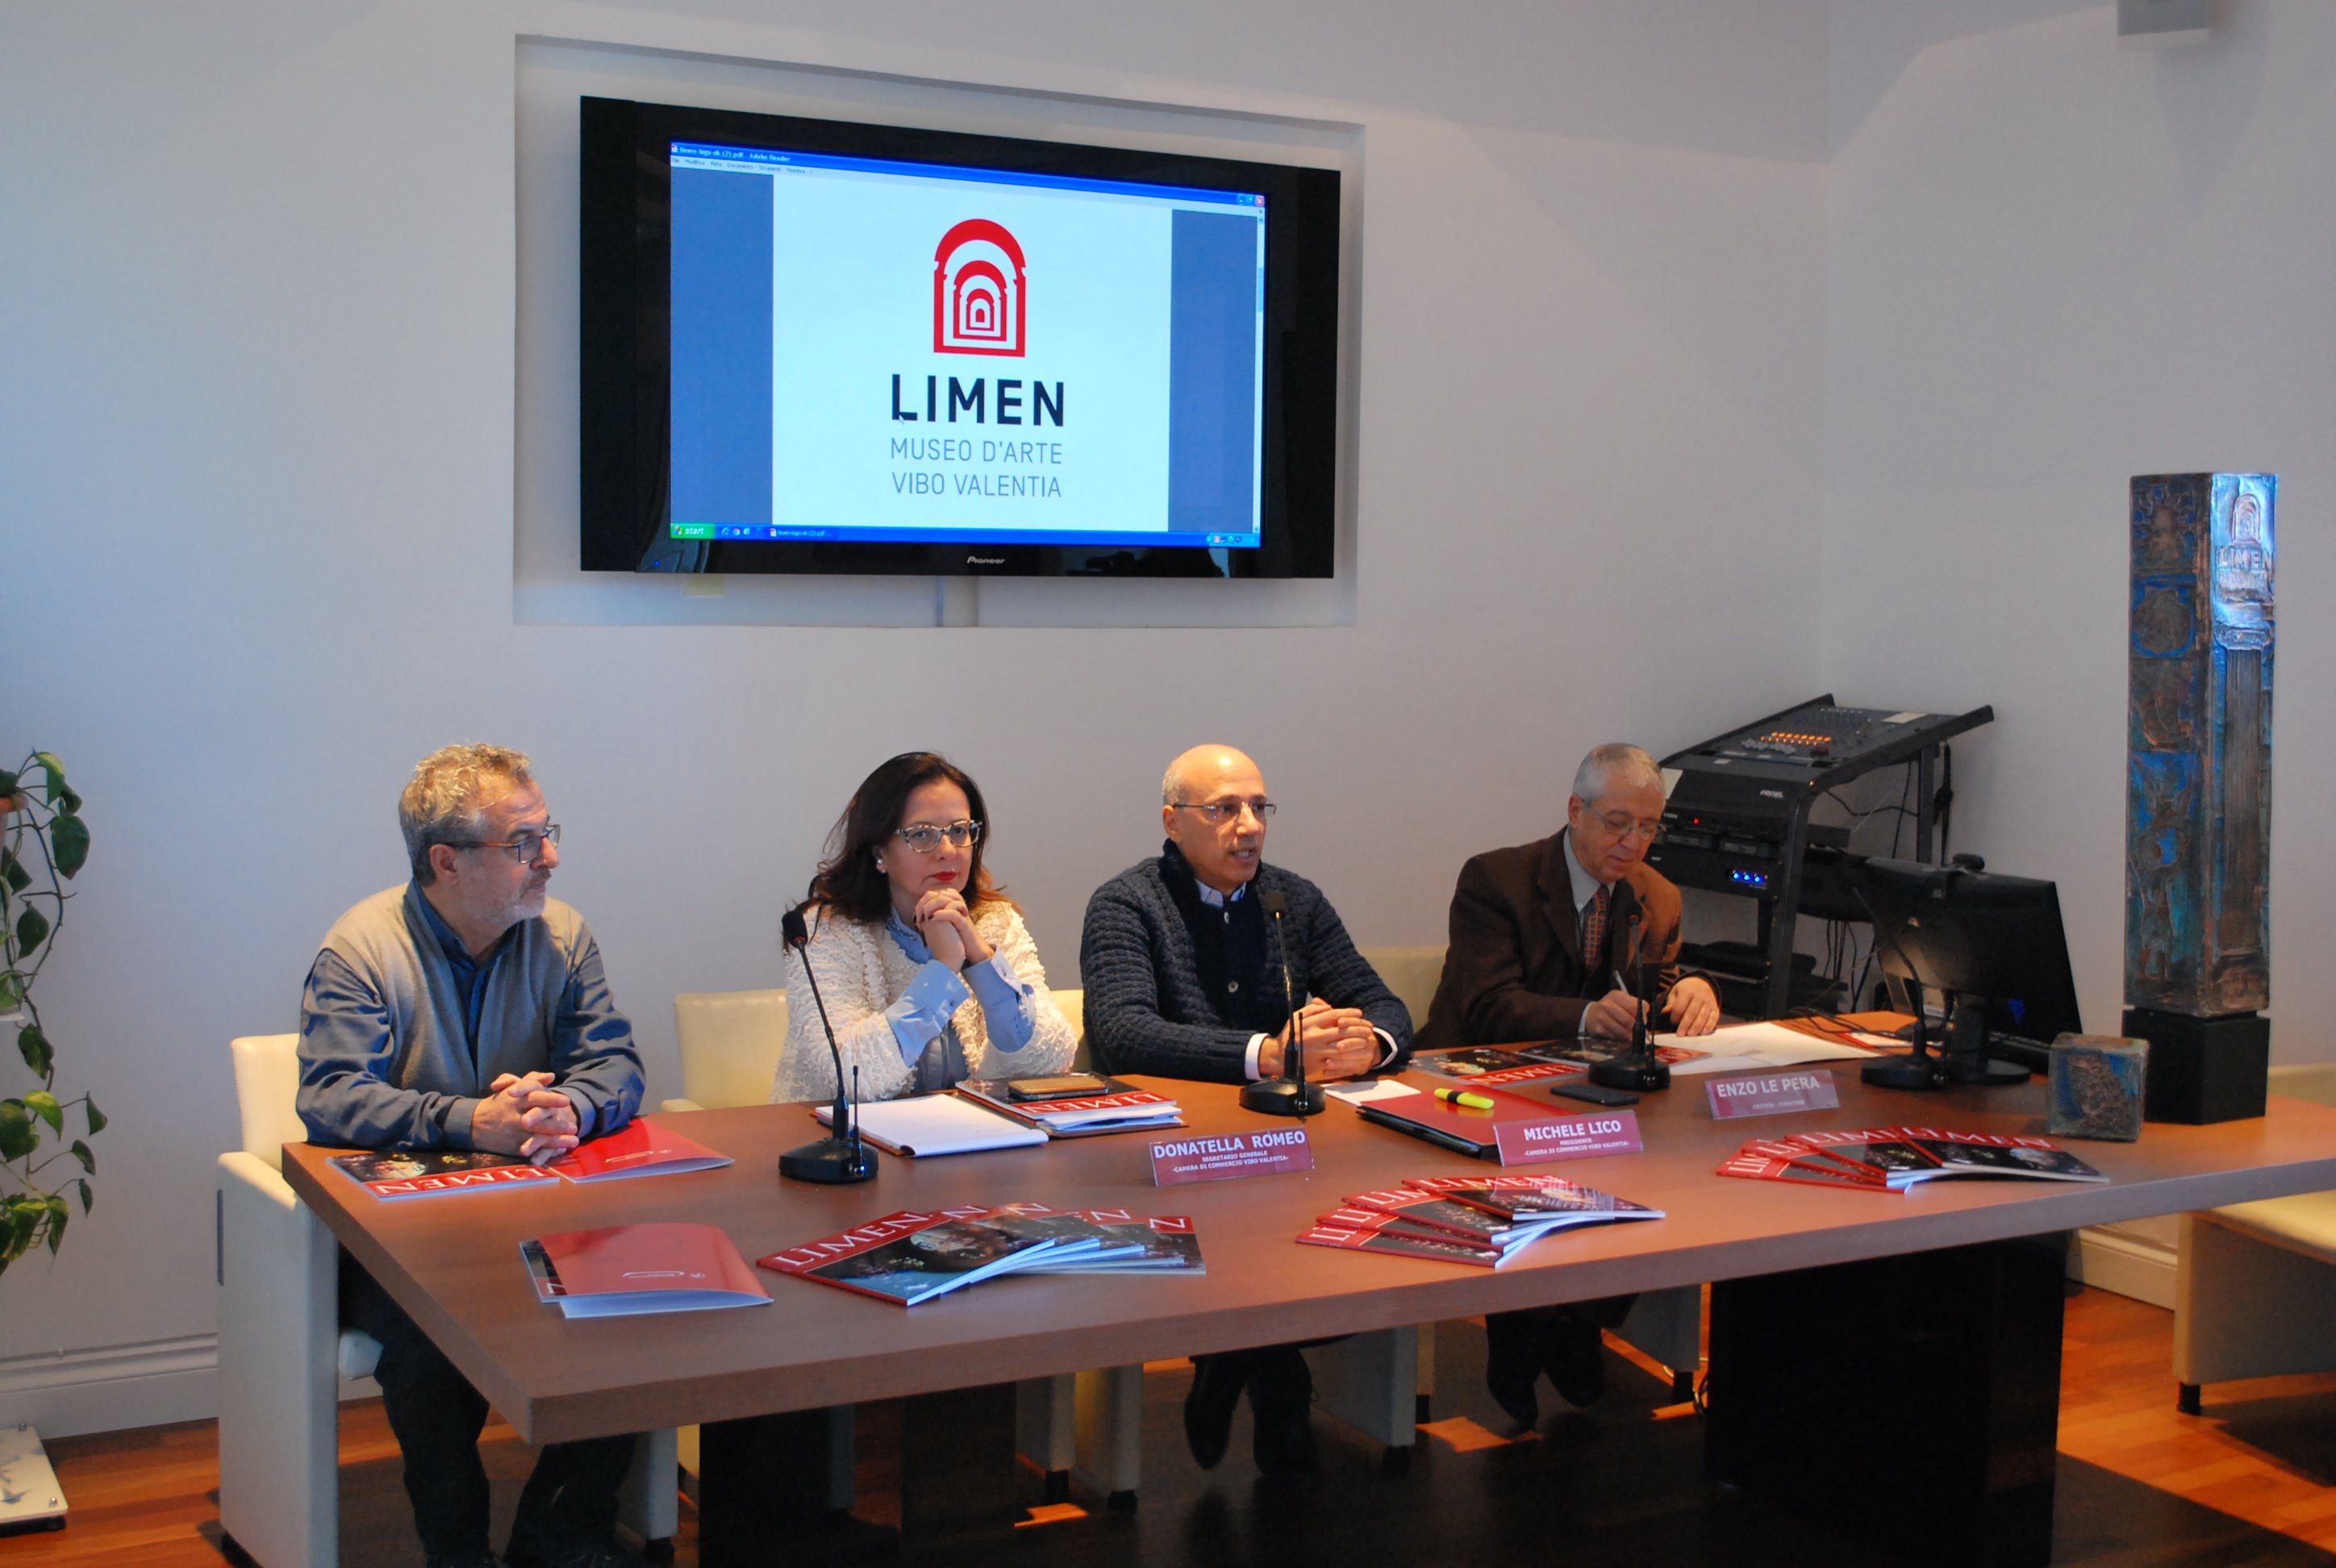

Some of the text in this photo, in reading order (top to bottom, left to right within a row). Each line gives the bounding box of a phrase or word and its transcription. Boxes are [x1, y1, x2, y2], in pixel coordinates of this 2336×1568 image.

[891, 373, 1064, 427] LIMEN
[891, 437, 1062, 465] MUSEO D'ARTE
[891, 471, 1062, 498] VIBO VALENTIA
[685, 527, 704, 536] start
[966, 556, 1006, 565] Pioneer
[2218, 547, 2273, 571] LIMEN
[1717, 1075, 1821, 1098] ENZO LE PERA
[1022, 1092, 1163, 1114] LIMEN
[1523, 1119, 1621, 1141] MICHELE LICO
[1153, 1130, 1306, 1159] DONATELLA ROMEO
[1556, 1144, 1588, 1153] COMMERCIO
[1559, 1137, 1592, 1146] PRESIDENTE
[1199, 1161, 1208, 1170] DI
[1208, 1159, 1243, 1170] COMMERCIO
[1243, 1157, 1258, 1166] VIBO
[1201, 1149, 1268, 1163] SEGRETARIO GENERALE
[375, 1167, 546, 1195] LIMEN
[1418, 1174, 1570, 1188] LIMEN
[773, 1212, 930, 1266] LIMEN
